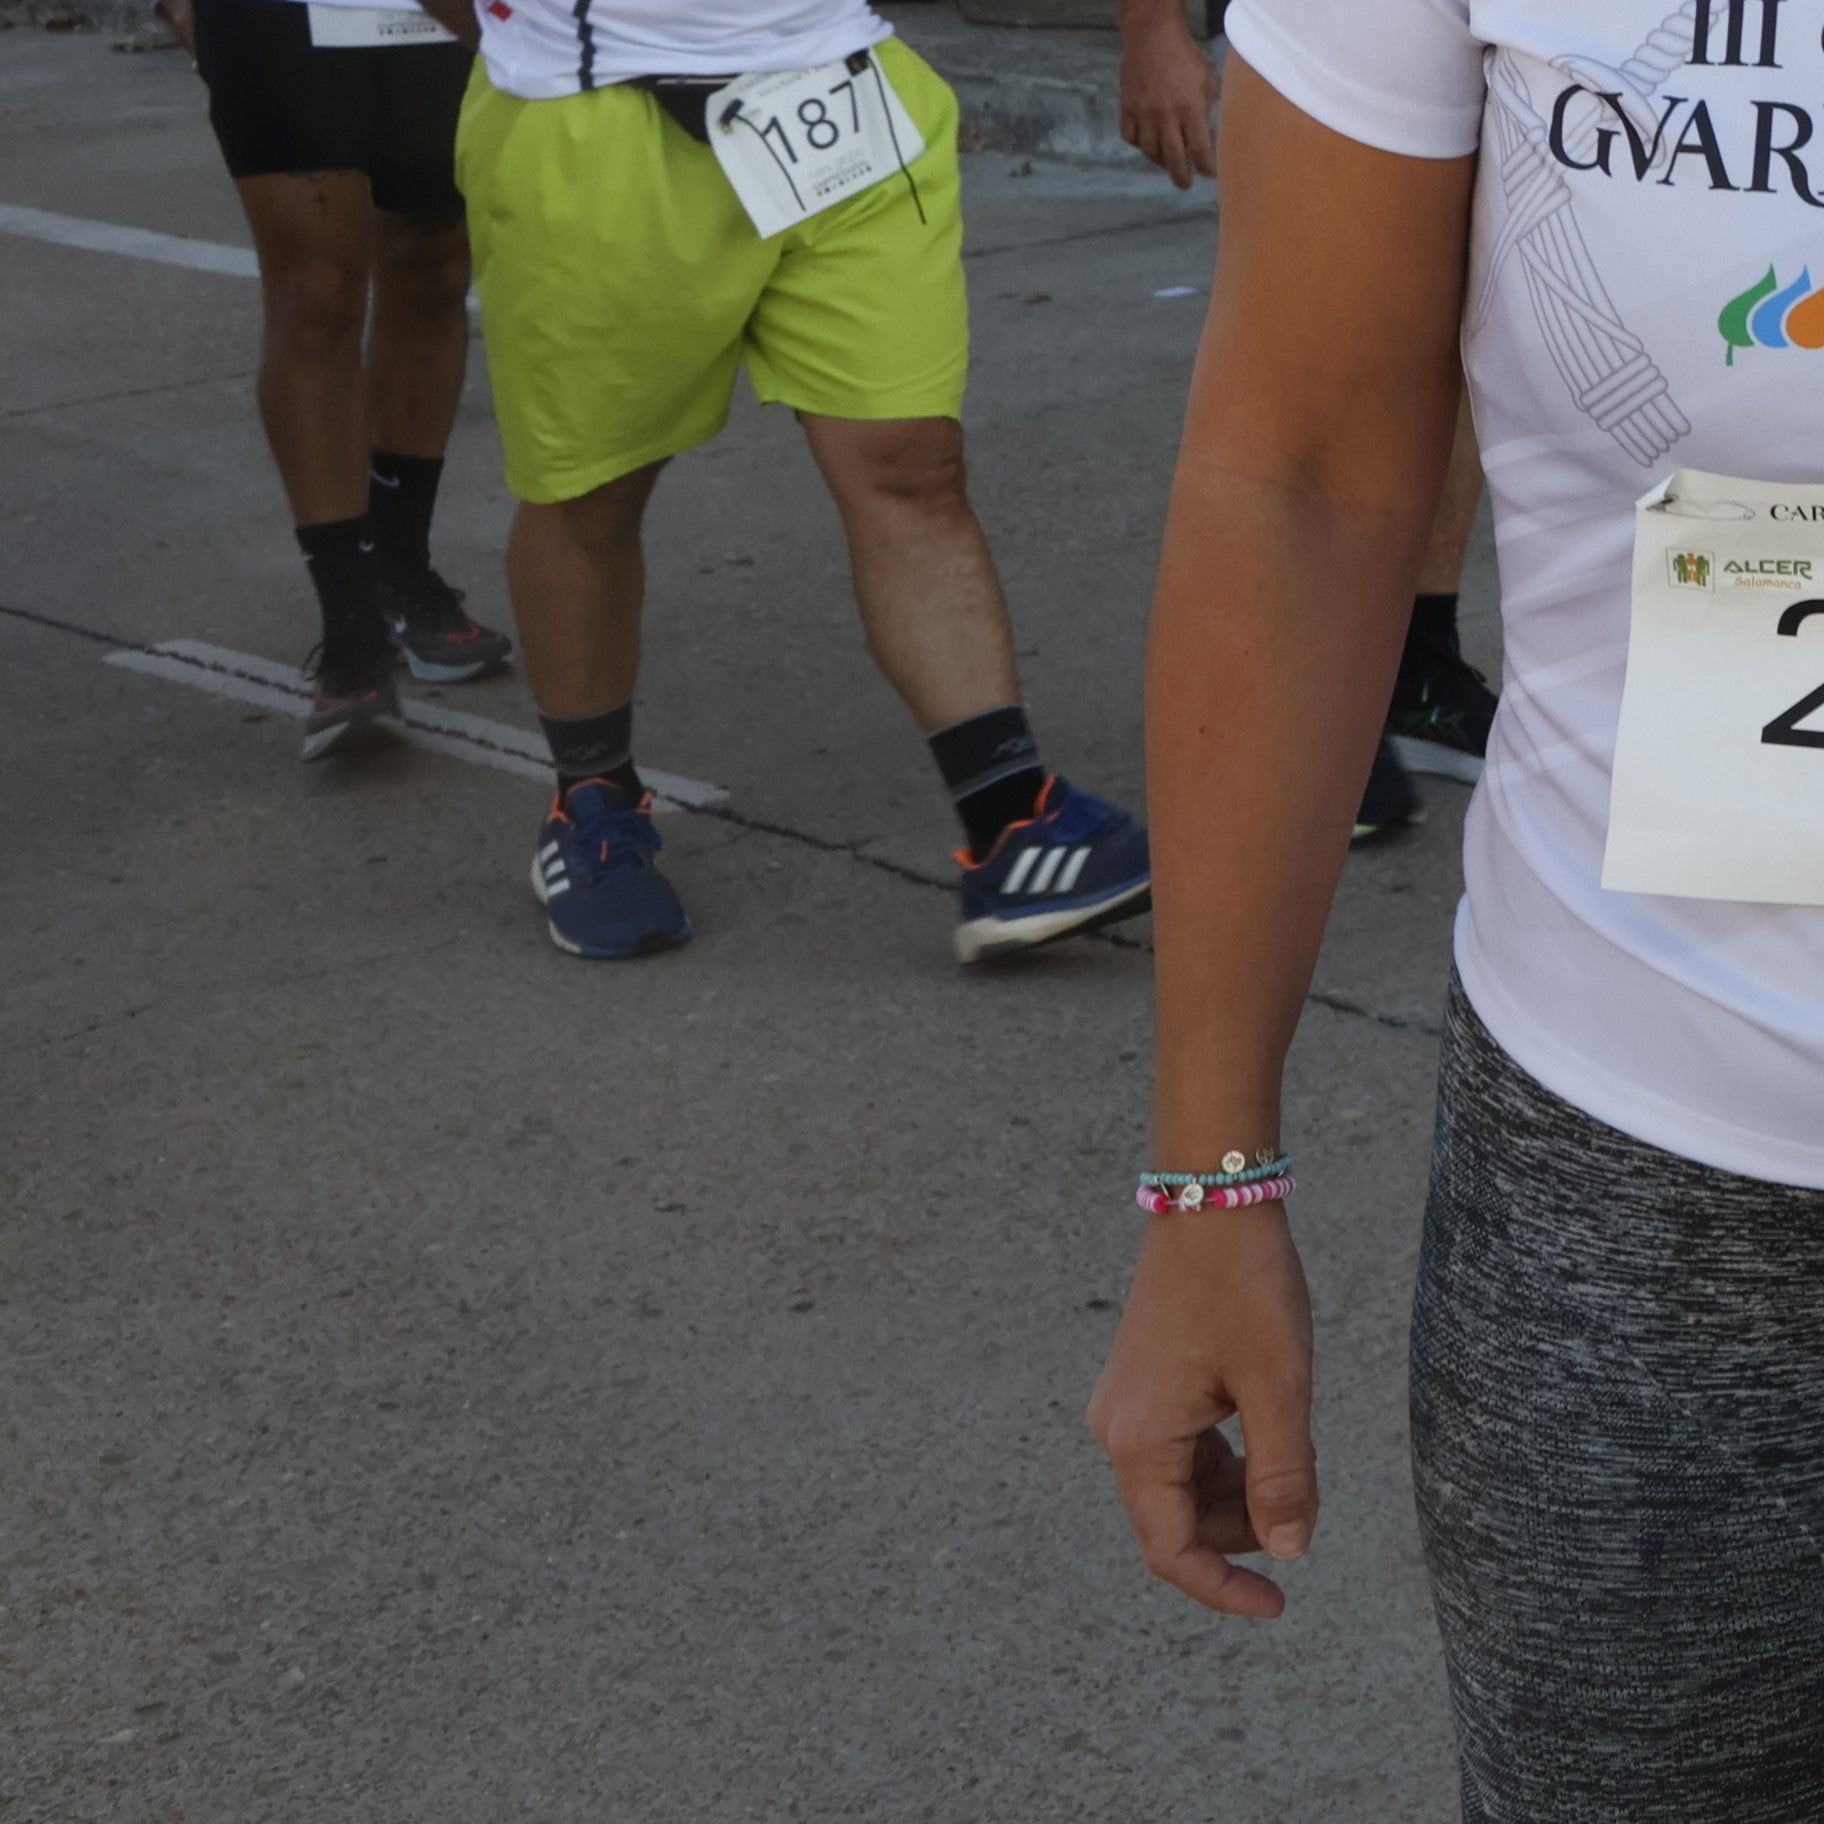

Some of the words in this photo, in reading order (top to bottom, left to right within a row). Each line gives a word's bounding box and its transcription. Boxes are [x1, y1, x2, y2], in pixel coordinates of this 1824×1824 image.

[762, 80, 859, 164] 187
[1723, 559, 1812, 581] ALCER
[1735, 577, 1802, 591] Salamanca
